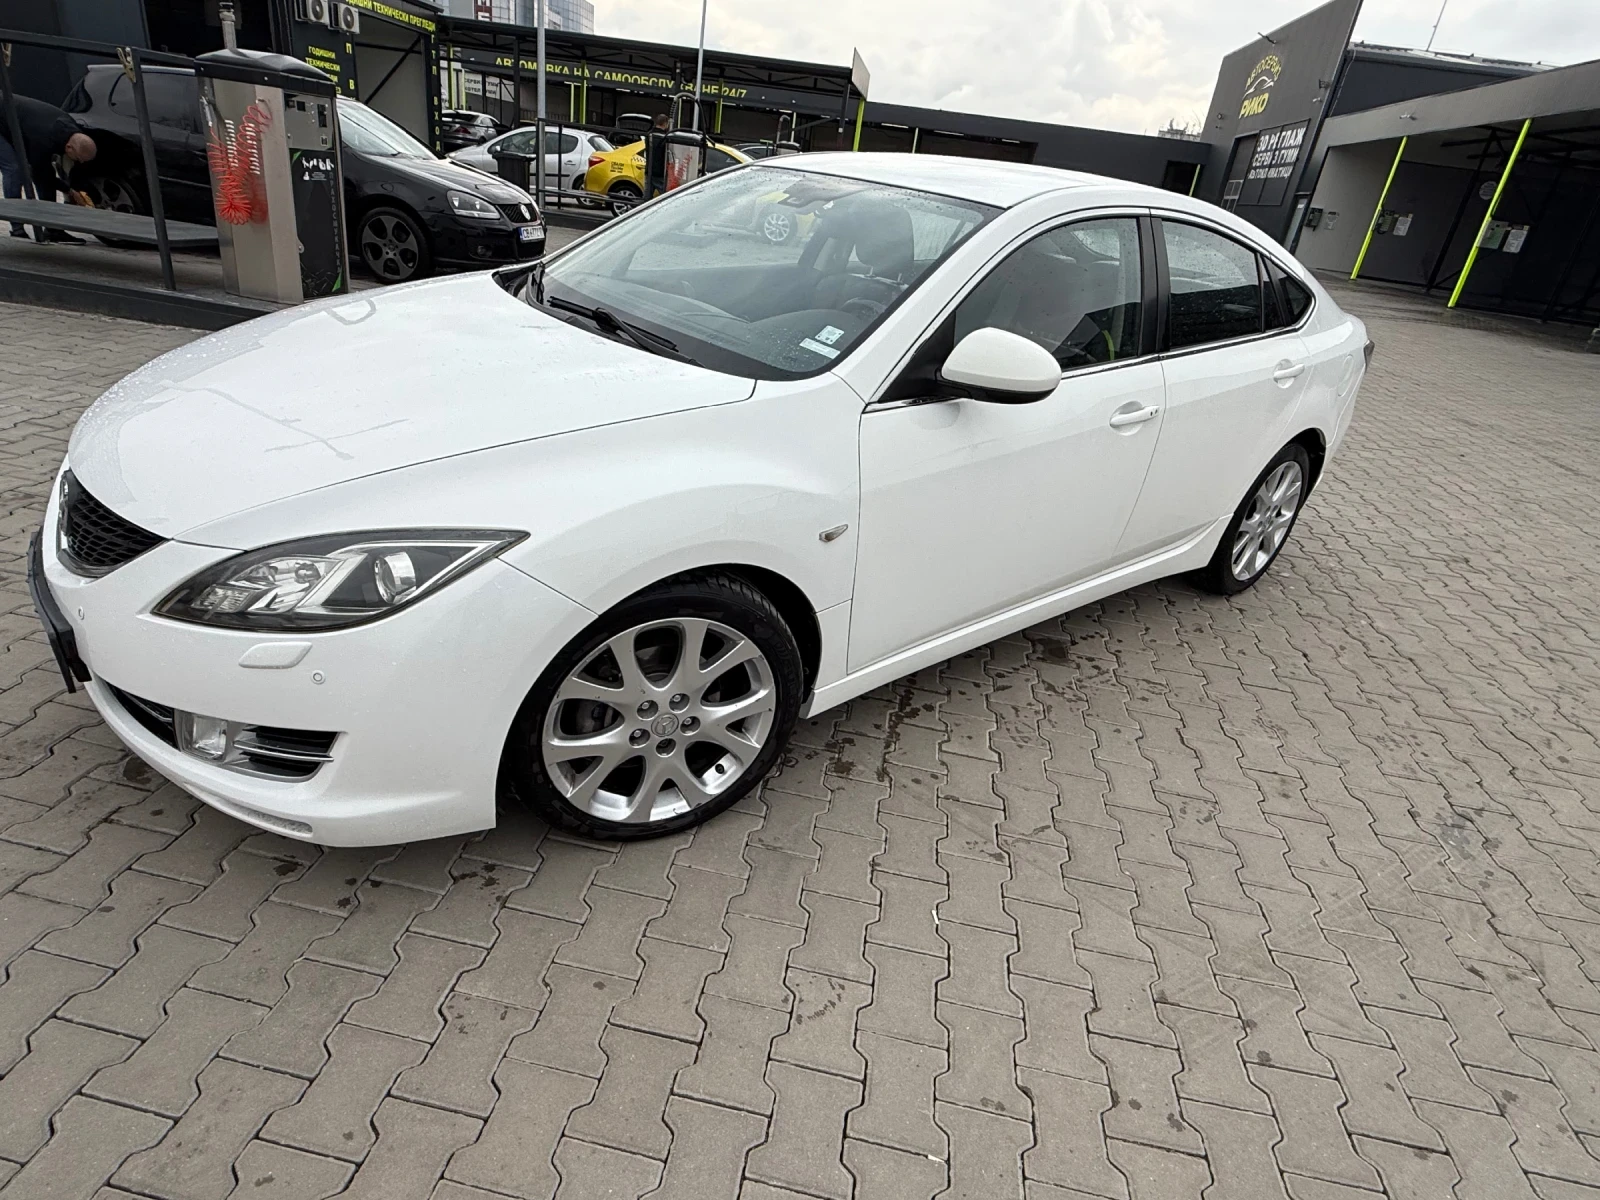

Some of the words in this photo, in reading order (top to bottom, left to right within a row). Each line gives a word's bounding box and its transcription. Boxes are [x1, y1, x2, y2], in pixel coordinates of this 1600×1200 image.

[346, 0, 372, 10] ДИШНИ
[373, 2, 409, 22] ТЕХНИЧЕСКИ
[409, 14, 436, 31] ПРЕГЛЕДИ
[308, 45, 336, 59] ГОДИШНИ
[305, 57, 341, 72] ТЕХНИЧЕСКИ
[495, 57, 570, 75] АВОМВКА
[1238, 92, 1269, 119] РИКО
[1277, 147, 1300, 164] ГУМИ
